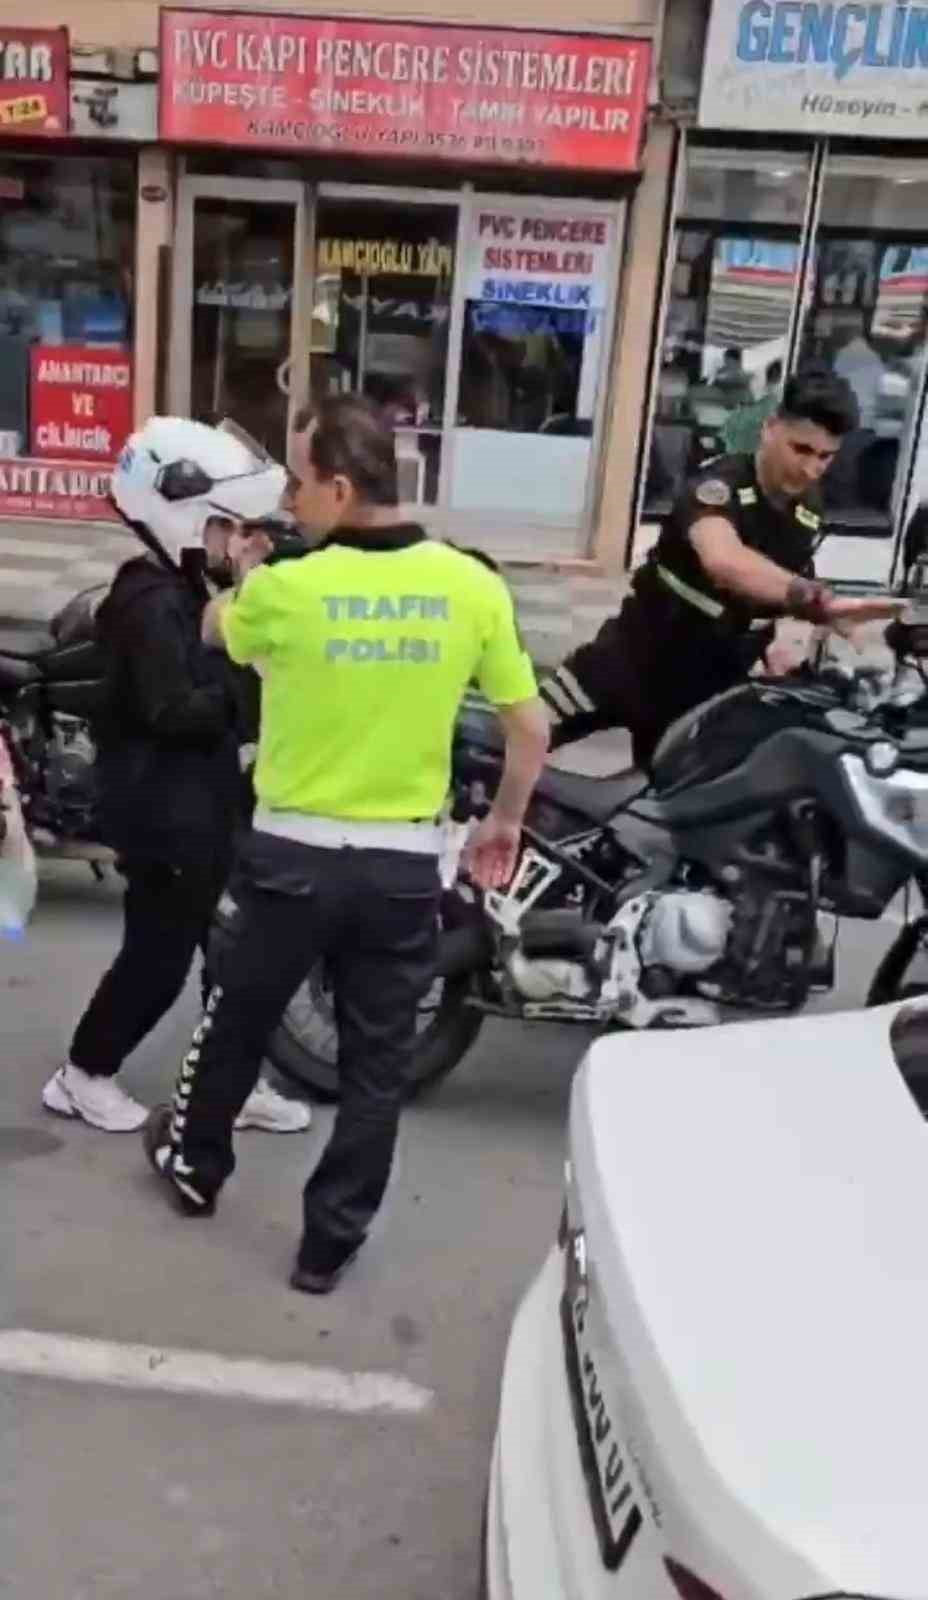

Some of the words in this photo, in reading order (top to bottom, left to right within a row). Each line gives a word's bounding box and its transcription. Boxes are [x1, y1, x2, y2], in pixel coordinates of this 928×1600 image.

[0, 41, 52, 81] AR
[173, 29, 228, 69] PVC
[236, 33, 306, 74] KAPI
[315, 38, 450, 83] PENCERE
[457, 41, 638, 97] SİSTEMLERİ
[479, 213, 515, 239] PVC
[72, 391, 94, 416] VE
